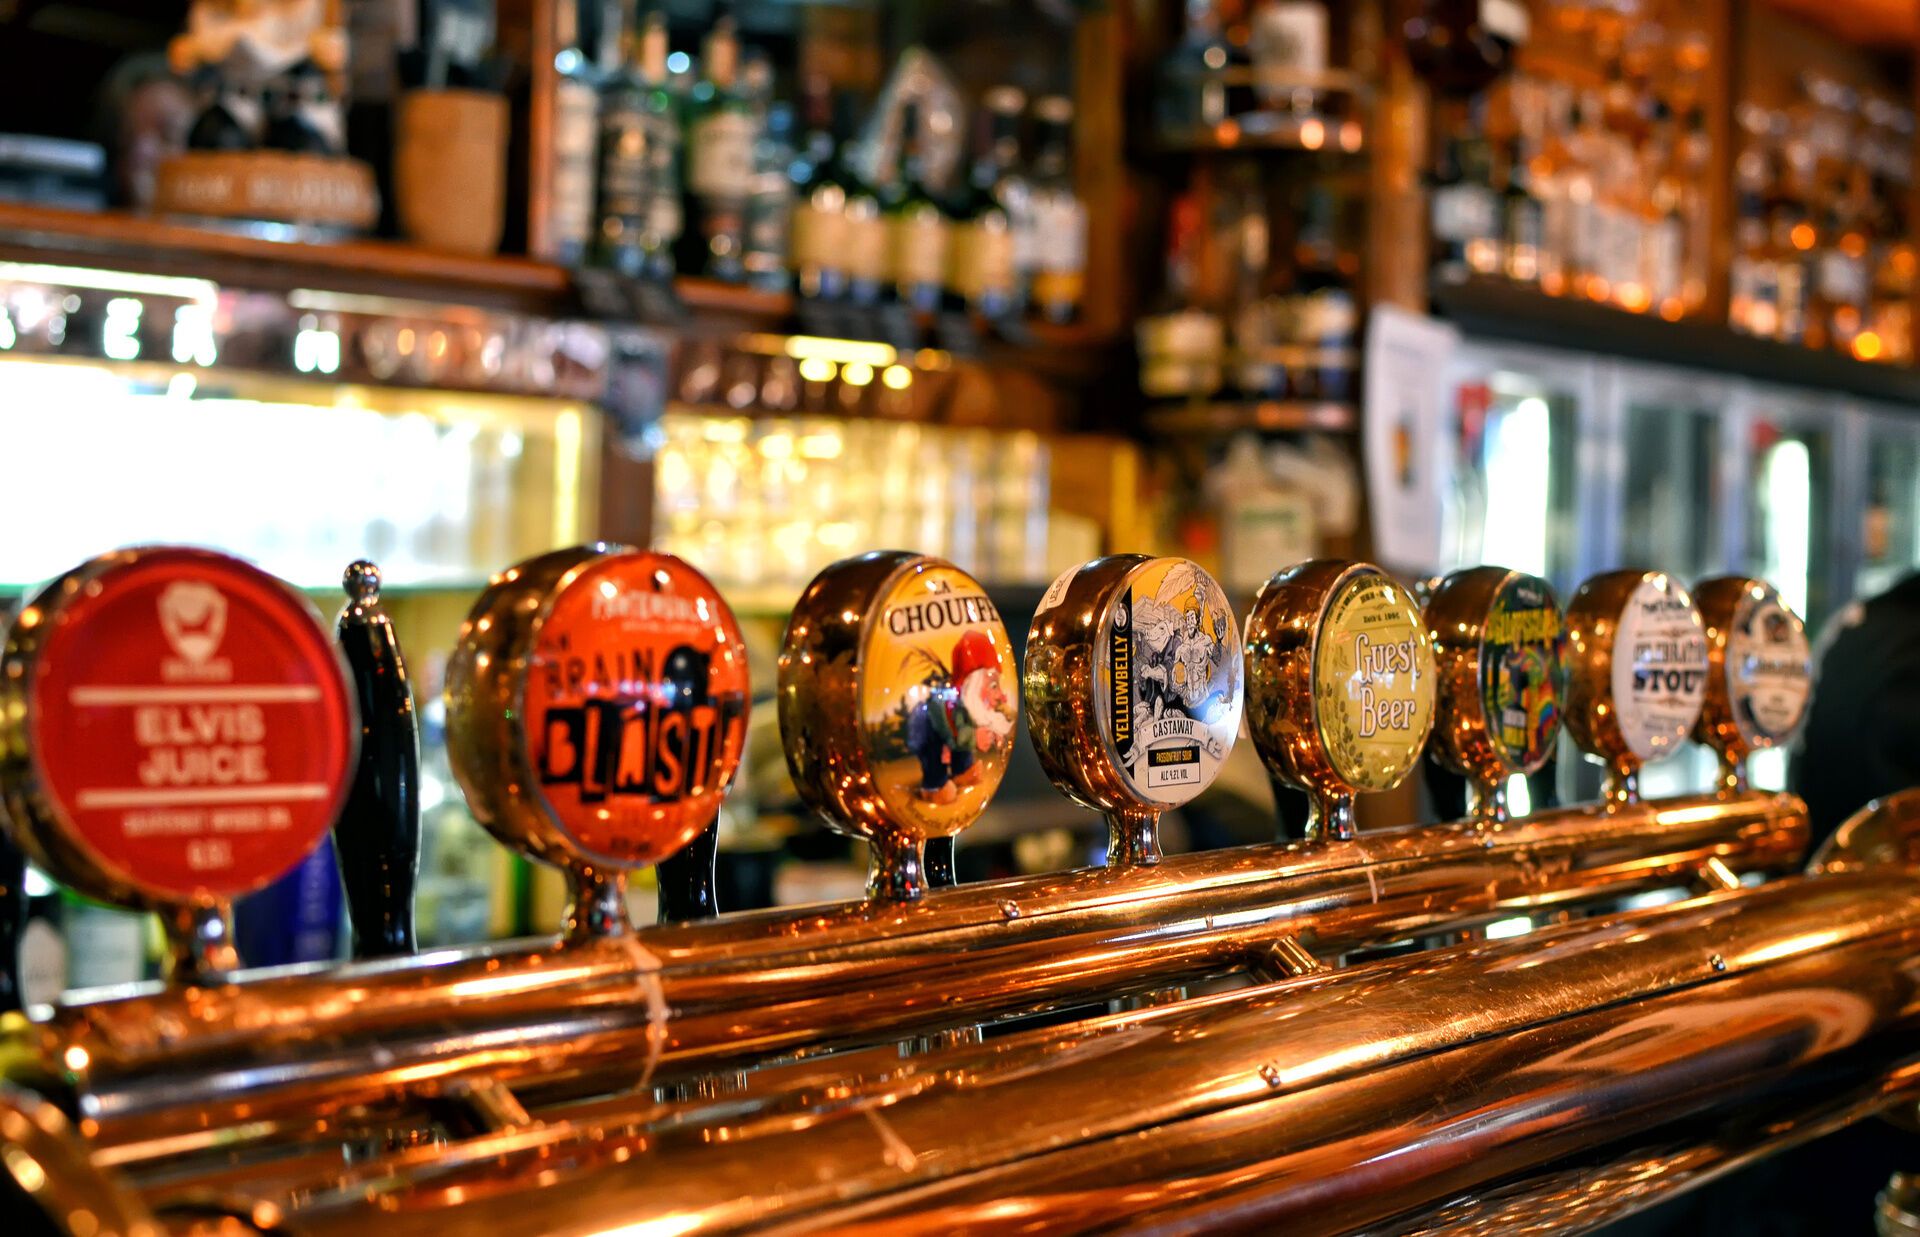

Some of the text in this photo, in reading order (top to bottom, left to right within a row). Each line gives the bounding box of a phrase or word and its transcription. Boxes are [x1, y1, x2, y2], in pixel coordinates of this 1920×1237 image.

[545, 647, 654, 697] BRAIN
[1354, 629, 1422, 684] Guest
[1114, 635, 1129, 743] YELLOWBELLY
[1359, 686, 1416, 736] Beer
[135, 703, 266, 744] ELVIS
[1152, 719, 1195, 738] CASTAWAY
[139, 746, 269, 786] JUICE
[1180, 769, 1188, 778] VOL
